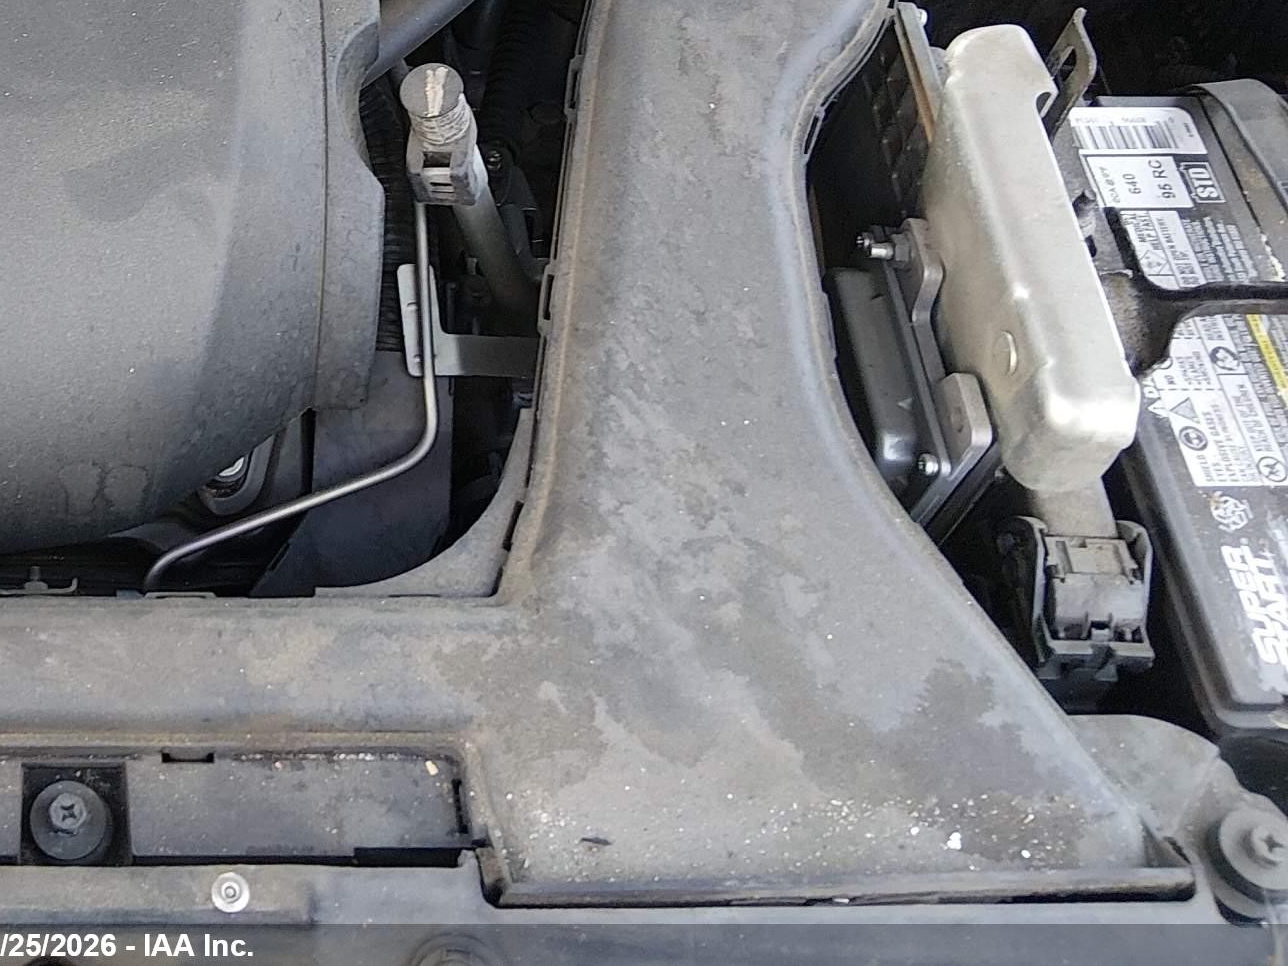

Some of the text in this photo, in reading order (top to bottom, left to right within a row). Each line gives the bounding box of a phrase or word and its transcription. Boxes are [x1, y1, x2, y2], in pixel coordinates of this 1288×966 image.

[1122, 173, 1142, 195] 640
[1148, 160, 1176, 199] 95 RC
[1188, 167, 1219, 199] STD
[1220, 545, 1278, 664] SUPER
